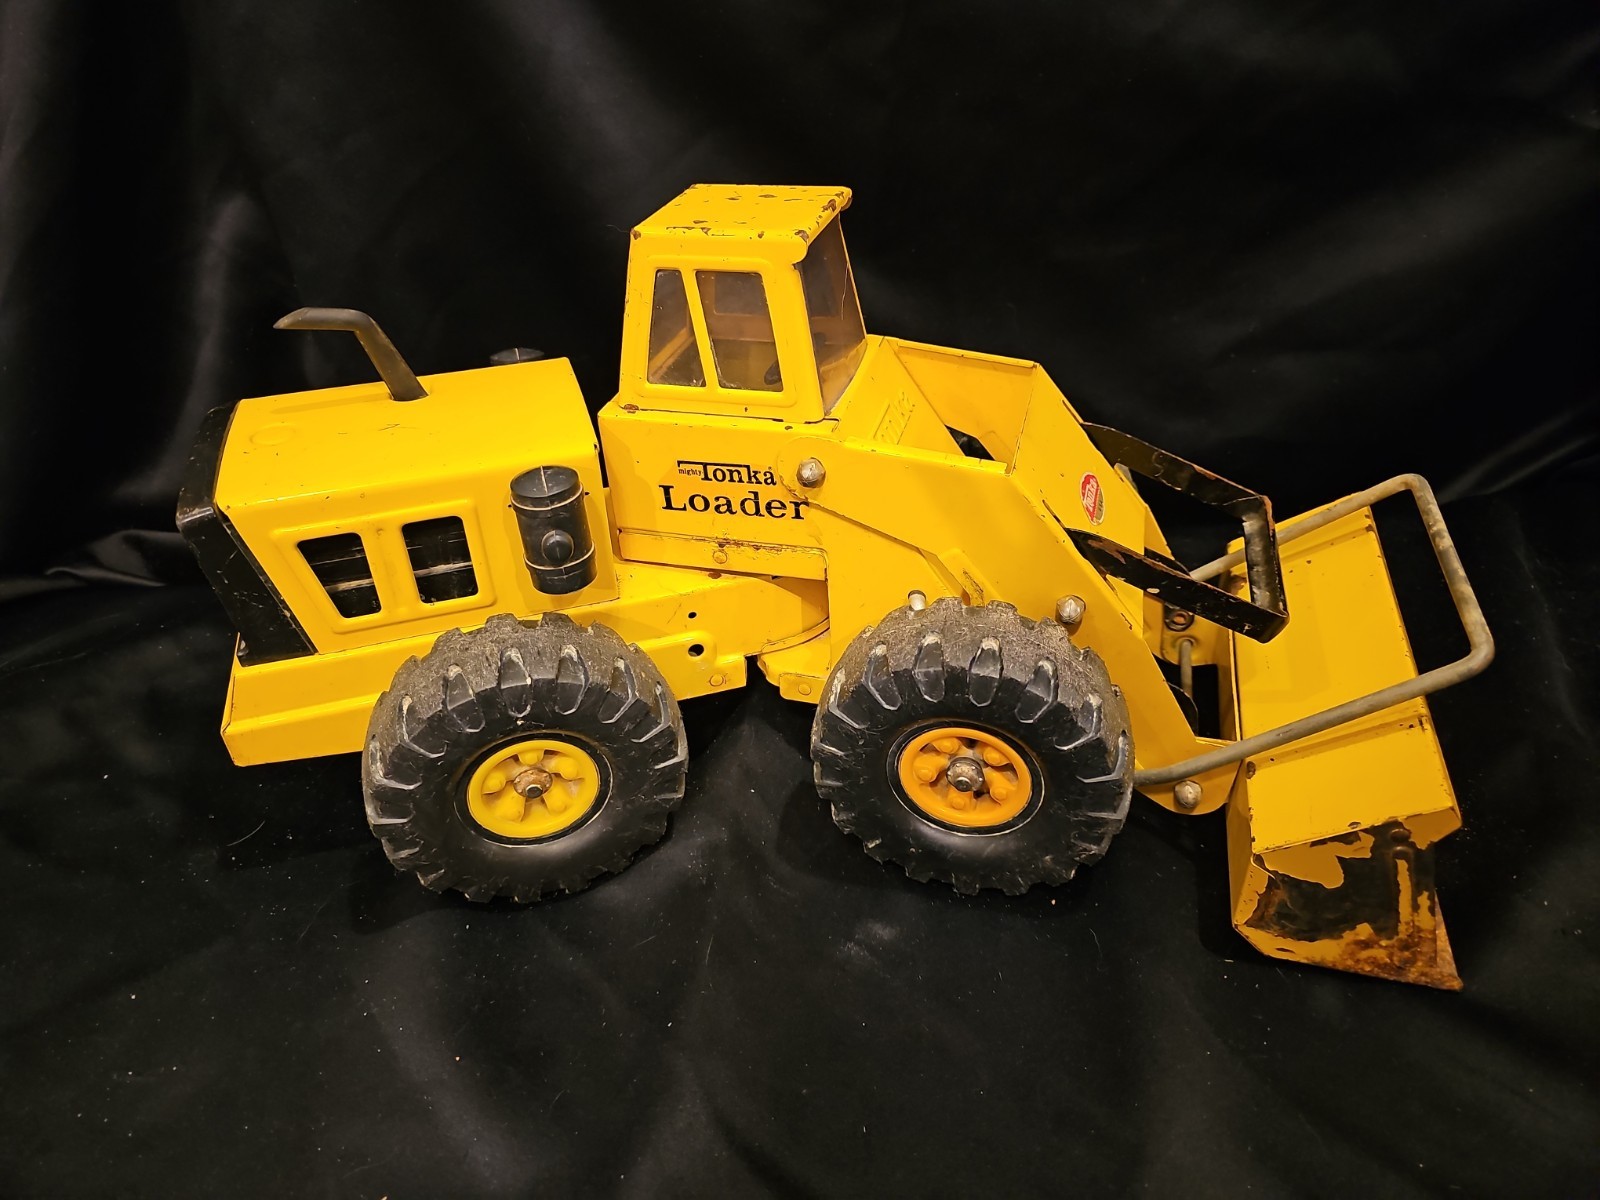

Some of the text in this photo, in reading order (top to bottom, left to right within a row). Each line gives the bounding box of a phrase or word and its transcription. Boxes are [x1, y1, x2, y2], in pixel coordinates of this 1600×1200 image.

[677, 460, 777, 486] mighty Tonka
[659, 485, 809, 520] Loader
